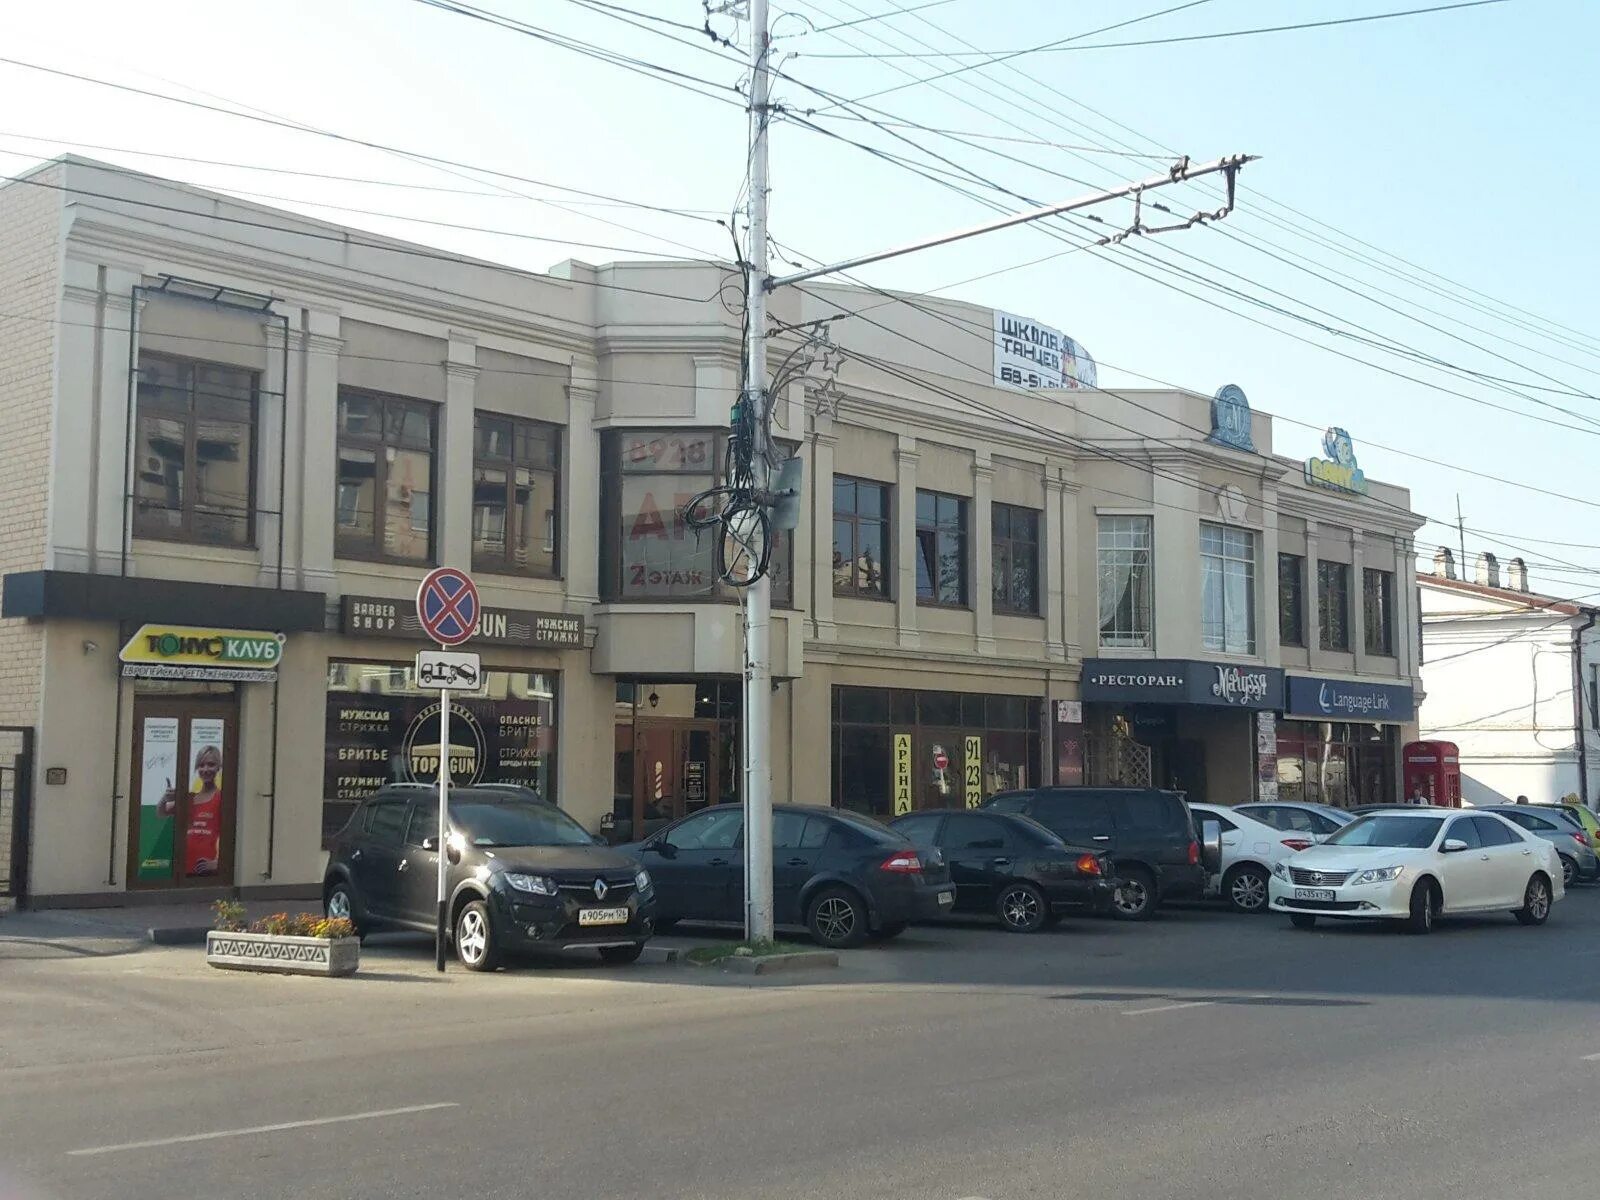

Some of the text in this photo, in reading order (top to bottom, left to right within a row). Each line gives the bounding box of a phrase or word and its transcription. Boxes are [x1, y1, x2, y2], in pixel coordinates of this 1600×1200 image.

[1001, 317, 1059, 352] ШКОЛА
[1001, 337, 1060, 370] ТАНЦЕВ
[353, 603, 396, 617] BARBER
[353, 617, 396, 630] SHOP
[536, 617, 579, 632] МУЖСКИЕ
[536, 630, 579, 643] СТРИЖКИ
[146, 633, 275, 659] ТОНУС КЛУБ
[1098, 674, 1176, 687] РЕСТОРАН
[1333, 689, 1389, 713] Language Link
[339, 709, 390, 721] МУЖСКАЯ
[499, 715, 542, 725] ОПАСНОЕ
[339, 722, 390, 732] СТРИЖКА
[499, 726, 541, 738] БРИТЬЕ
[338, 748, 389, 761] БРИТЬЕ
[499, 747, 541, 758] СТРИЖКА
[966, 739, 980, 760] 91
[411, 757, 476, 775] TOP GUN
[898, 737, 909, 812] АРЕНДА
[966, 765, 980, 786] 23
[337, 776, 387, 787] ГРУМИНГ
[337, 787, 378, 799] СТАЙЛИ
